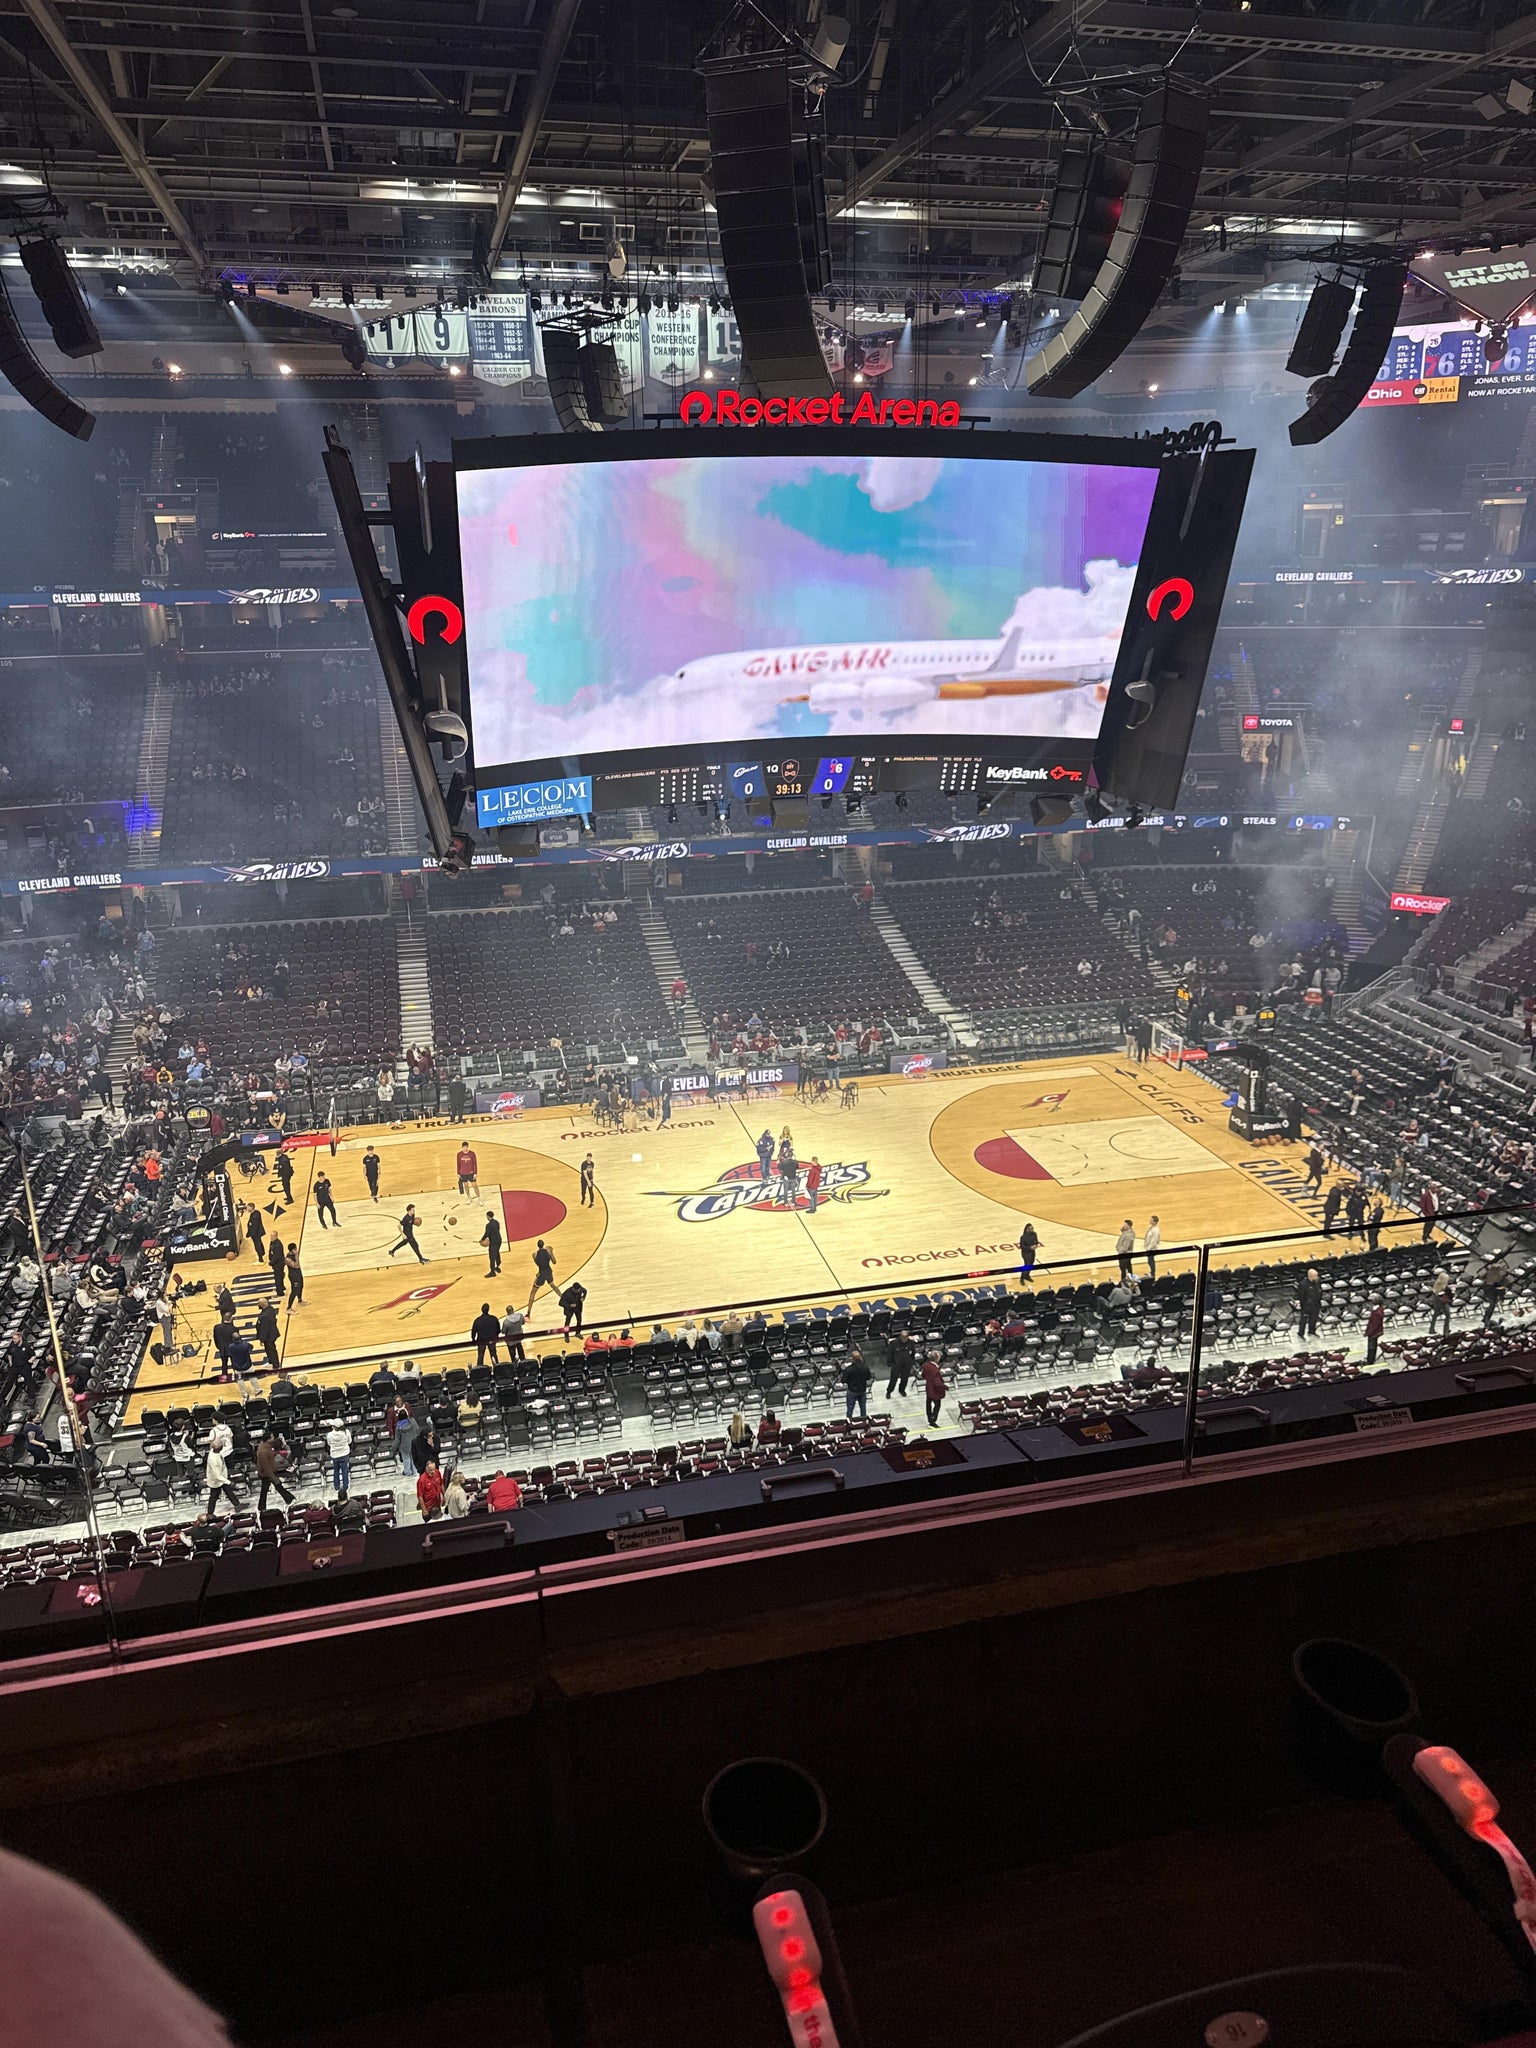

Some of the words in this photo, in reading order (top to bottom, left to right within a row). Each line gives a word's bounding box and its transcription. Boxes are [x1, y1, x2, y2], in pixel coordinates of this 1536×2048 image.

[1444, 266, 1487, 280] LET
[1490, 260, 1528, 273] EM
[480, 305, 516, 314] BARONS
[655, 308, 691, 319] 2015-16
[624, 319, 640, 330] CUP
[656, 323, 691, 333] WESTERN
[433, 318, 450, 350] 9
[651, 334, 697, 345] CONFERENCE
[716, 322, 742, 355] 15
[653, 346, 695, 357] CHAMPIONS
[1425, 352, 1455, 376] 76
[1368, 388, 1402, 399] Ohio
[1429, 385, 1456, 394] Rental
[1468, 389, 1486, 397] NOW
[716, 390, 845, 425] Rocket
[851, 391, 960, 427] Arena
[1275, 572, 1314, 582] CLEVELAND
[1316, 571, 1353, 581] CAVALIERS
[52, 593, 97, 604] CLEVELAND
[99, 592, 141, 603] CAVALIERS
[832, 648, 893, 671] AIR
[1260, 718, 1293, 727] TOYOTA
[766, 764, 779, 774] 1Q
[986, 766, 1049, 780] KeyBank
[744, 782, 753, 795] 0
[776, 783, 802, 795] 39:13
[824, 779, 833, 791] 0
[537, 803, 562, 812] COLLEGE
[507, 811, 546, 822] OSTEOPATHIC
[546, 807, 574, 816] MEDICINE
[1220, 816, 1228, 826] 0
[1243, 817, 1277, 825] STEALS
[1295, 817, 1303, 827] 0
[767, 837, 807, 849] CLEVELAND
[809, 835, 848, 846] CAVALIERS
[18, 876, 71, 892] CLEVELAND
[73, 873, 122, 887] CAVALIERS
[929, 1064, 1026, 1078] TRUSTEDSEC
[1138, 1084, 1205, 1124] CLIFFS
[580, 1124, 651, 1140] Rocket
[656, 1118, 715, 1132] Arena
[1252, 1121, 1283, 1132] KeyBank
[170, 1241, 210, 1255] KeyBank
[883, 1247, 970, 1267] Rocket
[1392, 1410, 1408, 1418] Date
[617, 1529, 660, 1542] Production
[661, 1526, 680, 1535] Date
